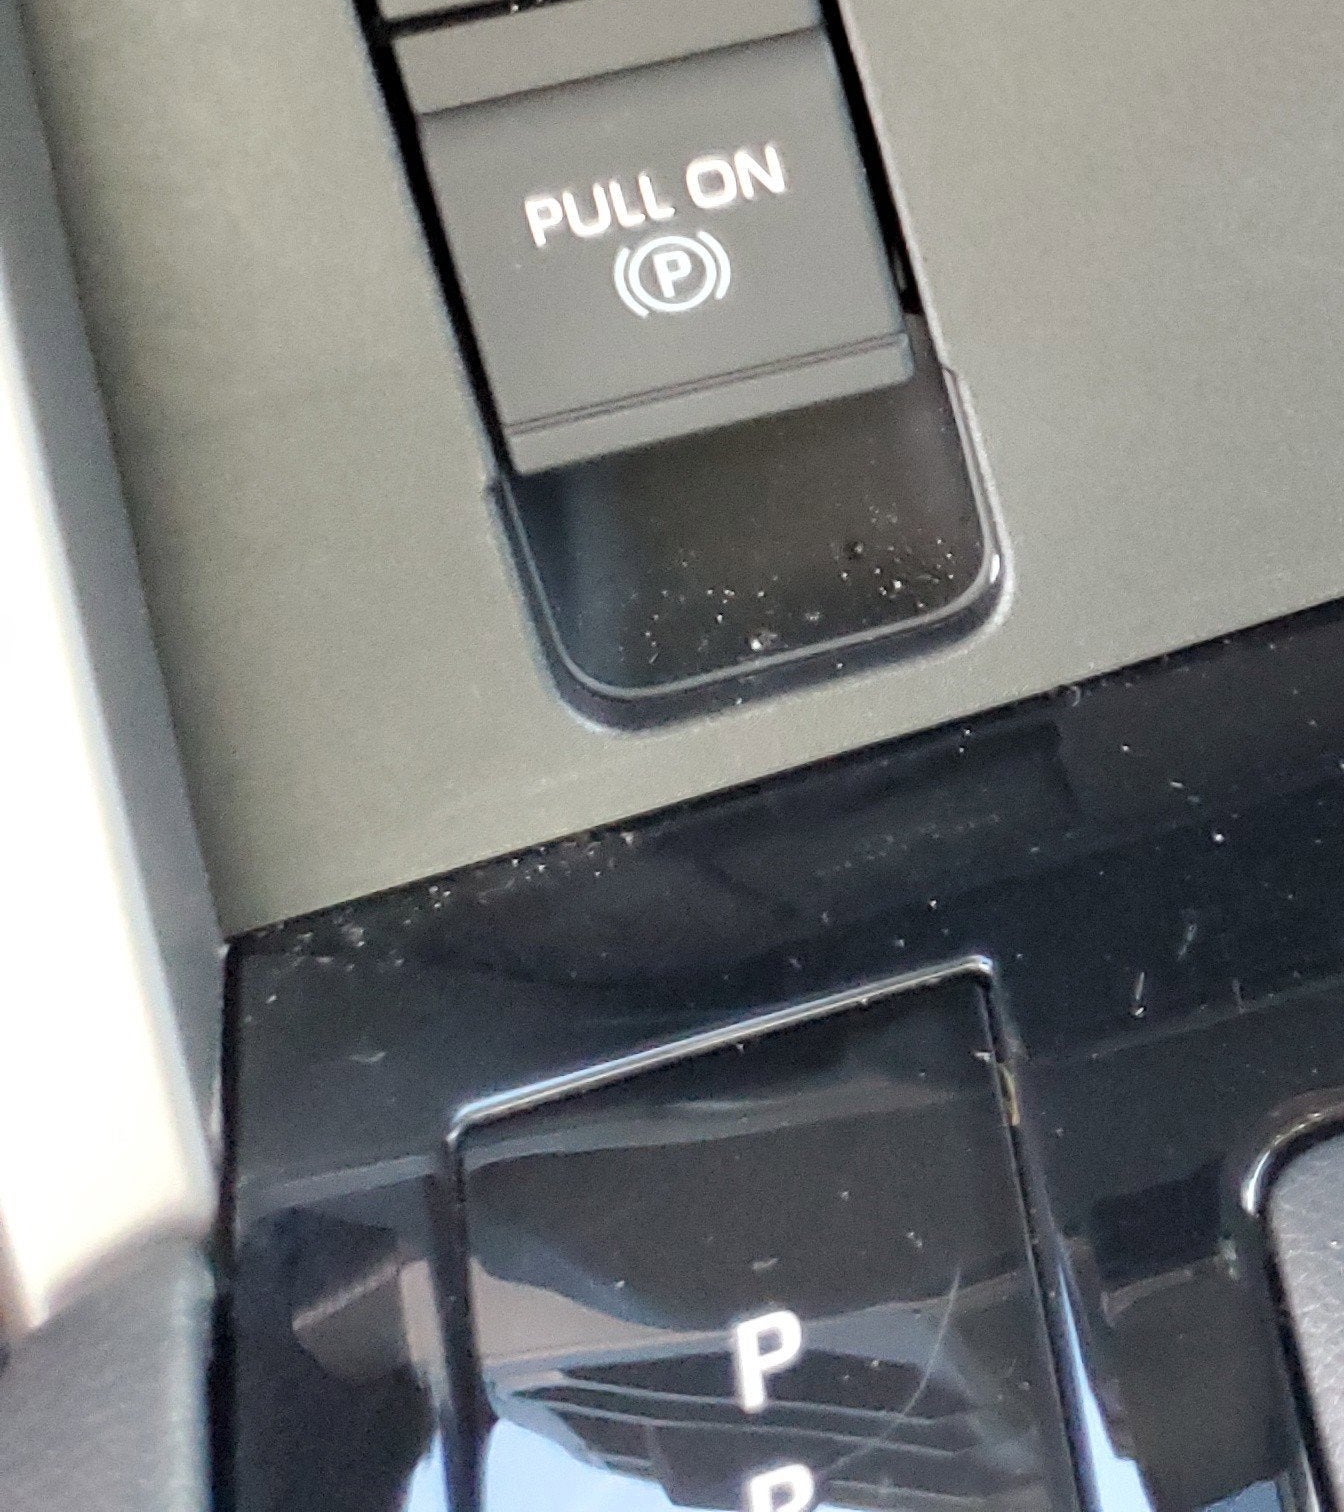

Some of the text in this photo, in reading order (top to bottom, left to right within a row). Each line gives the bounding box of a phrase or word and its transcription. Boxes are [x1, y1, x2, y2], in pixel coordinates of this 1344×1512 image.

[524, 141, 787, 248] PULL ON
[652, 250, 693, 299] P
[735, 1309, 803, 1415] P
